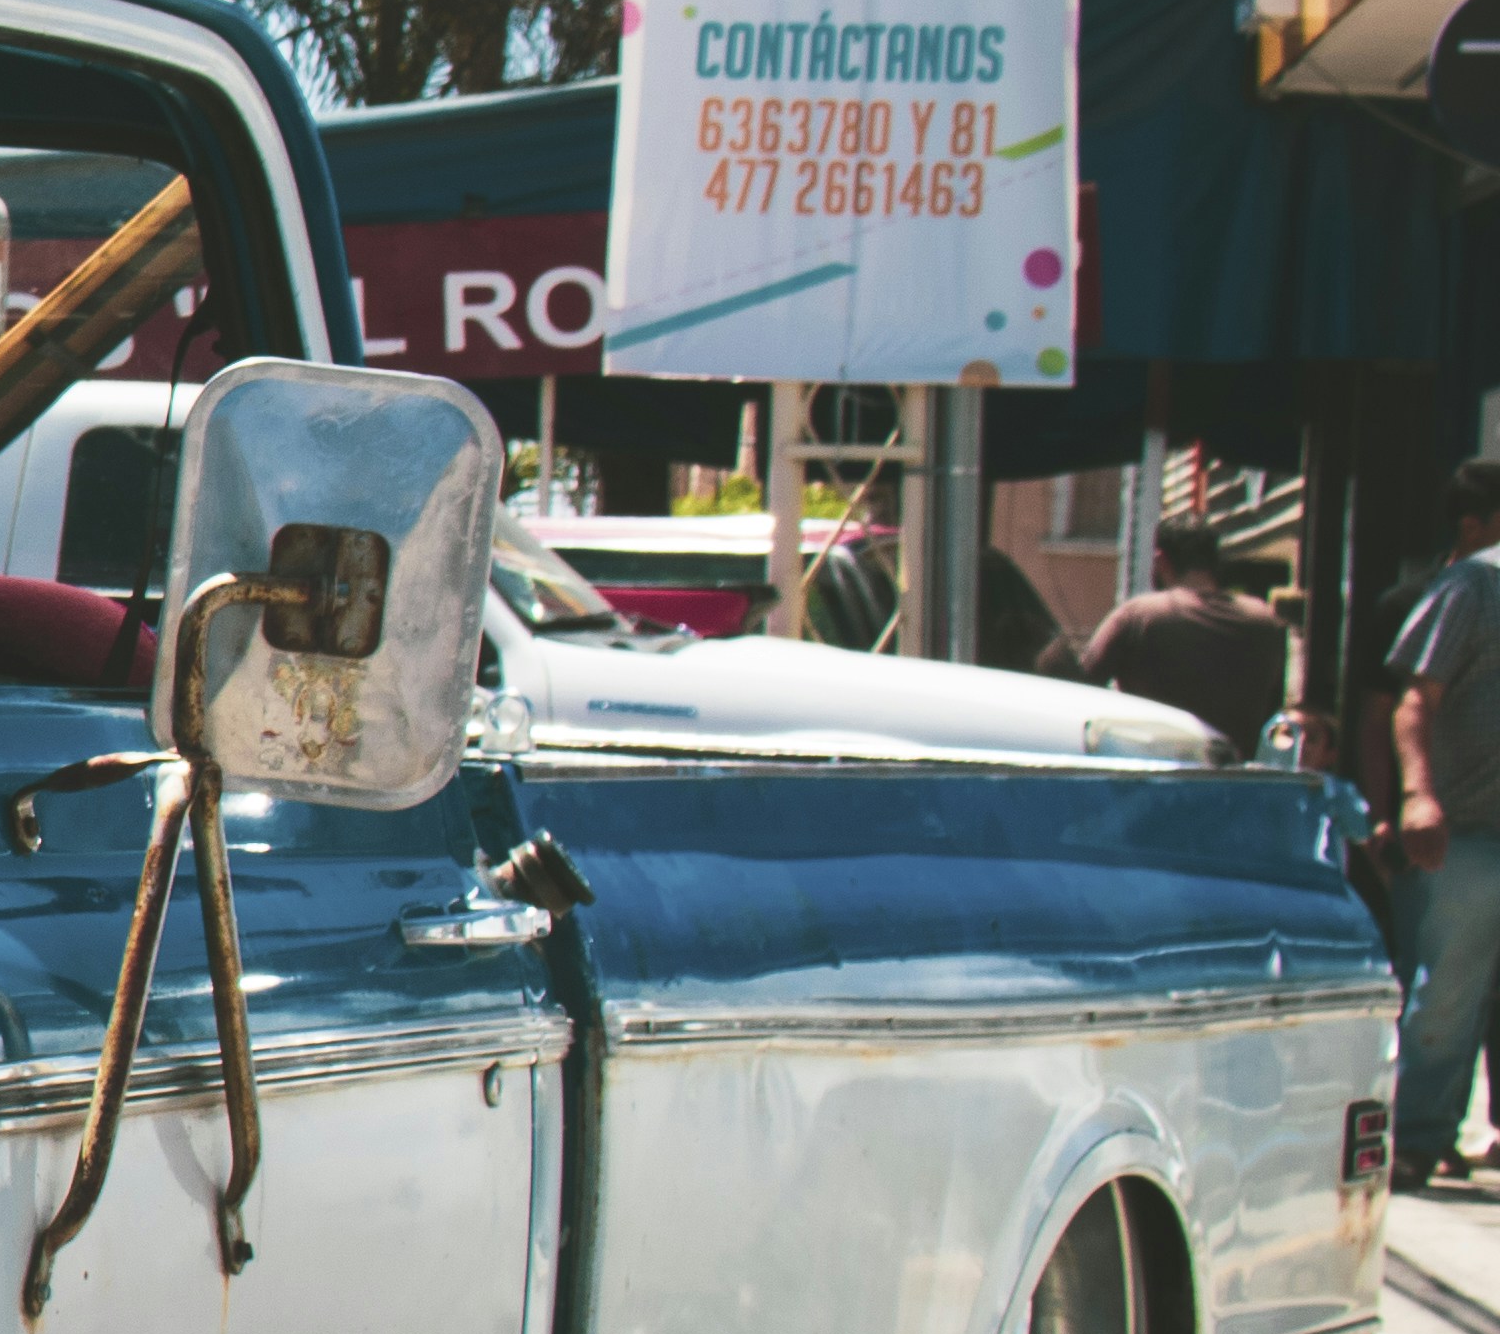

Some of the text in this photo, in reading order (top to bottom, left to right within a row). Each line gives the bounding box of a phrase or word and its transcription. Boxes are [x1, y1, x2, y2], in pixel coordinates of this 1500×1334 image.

[696, 9, 1006, 83] CONTÁCTANOS
[697, 97, 997, 157] 6363780 Y 81
[704, 158, 985, 217] 477 2661463
